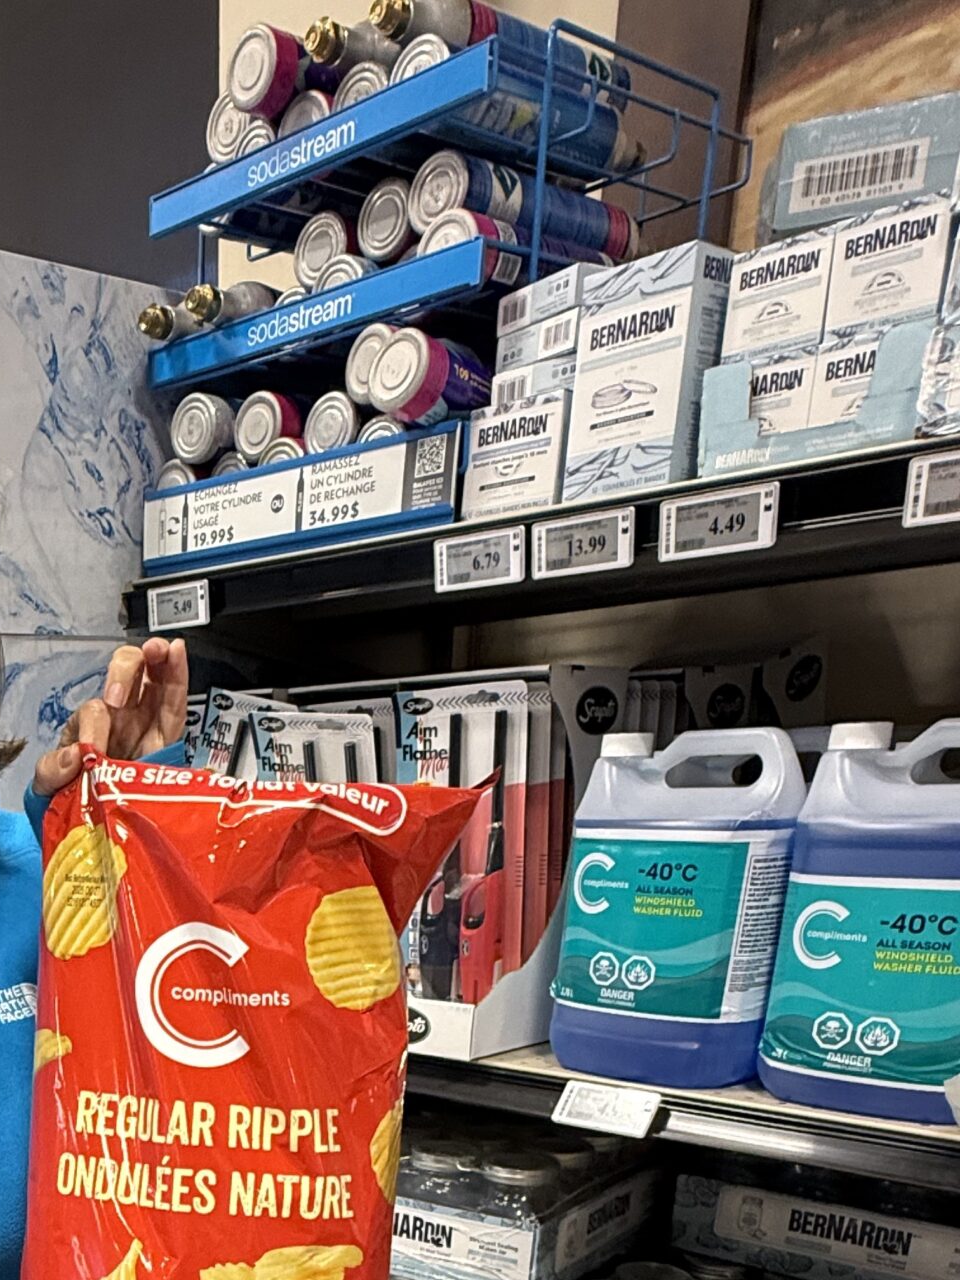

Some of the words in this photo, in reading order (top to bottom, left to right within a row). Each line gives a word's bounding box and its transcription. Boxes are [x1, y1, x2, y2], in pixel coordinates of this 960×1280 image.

[247, 119, 356, 187] sodastream
[844, 214, 938, 260] BERNARDIN
[739, 249, 822, 292] BERNARDIN
[247, 293, 353, 347] sodastream
[590, 305, 676, 351] BERNARDIN
[478, 414, 549, 448] BERNARDIN
[311, 455, 361, 475] RAMASSEZ
[311, 478, 324, 490] UN
[326, 467, 373, 487] CYLINDRE
[193, 504, 220, 514] VOTRE
[221, 492, 262, 510] CYLINDRE
[271, 497, 284, 509] OU
[309, 493, 321, 505] DE
[324, 481, 376, 503] RECHANGE
[193, 515, 219, 530] USAGÉ
[309, 501, 359, 526] 34.99$
[709, 512, 746, 535] 4.49
[193, 525, 234, 547] 19.99$
[567, 534, 606, 559] 13.99
[472, 551, 500, 571] 6.79
[173, 599, 192, 615] 5.49
[208, 714, 231, 733] Aim
[407, 719, 438, 740] Aim
[264, 737, 292, 755] Aim
[402, 744, 448, 762] Flame
[261, 756, 305, 773] Flame
[141, 766, 191, 785] size
[304, 781, 389, 815] valeur
[638, 863, 698, 882] -40°C
[583, 879, 630, 891] compliments
[635, 886, 652, 895] ALL
[653, 887, 693, 897] SEASON
[633, 906, 671, 917] WASHER
[673, 907, 703, 918] FLUID
[635, 896, 695, 908] WINDSHIELD
[880, 914, 959, 936] -40°C
[806, 929, 868, 943] compliments
[877, 939, 897, 949] ALL
[900, 940, 951, 951] SEASON
[874, 961, 921, 973] WASHER
[875, 951, 954, 963] WINDSHIELD
[170, 983, 291, 1009] compliments
[601, 987, 634, 1001] DANGER
[0, 1007, 34, 1025] FACE
[826, 1052, 872, 1068] DANGER
[76, 1090, 215, 1148] REGULAR
[228, 1105, 341, 1154] RIPPLE
[57, 1152, 218, 1215] ONDULÉES
[229, 1171, 354, 1220] NATURE
[788, 1208, 913, 1256] BERNARDIN
